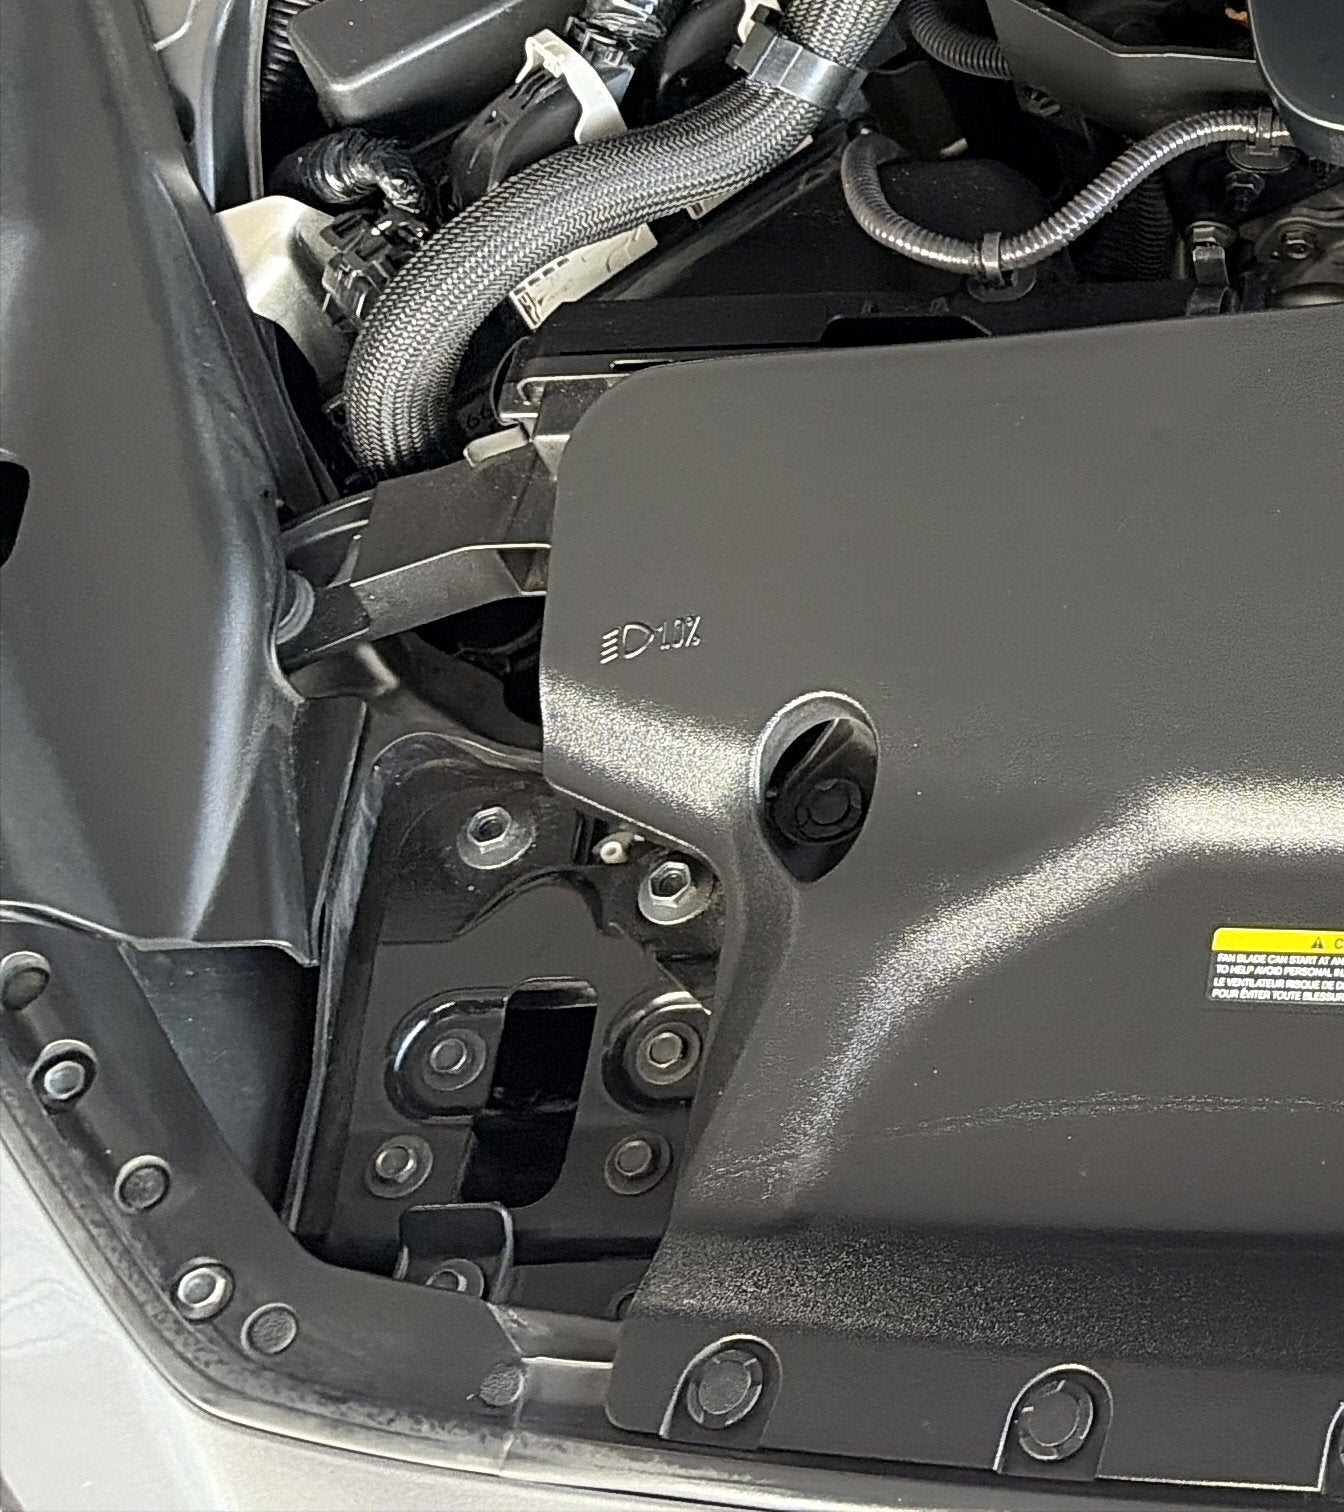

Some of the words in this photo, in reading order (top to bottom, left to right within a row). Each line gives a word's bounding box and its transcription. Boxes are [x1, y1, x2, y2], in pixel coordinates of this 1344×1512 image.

[1217, 953, 1236, 963] FAN
[1236, 953, 1267, 964] BLADE
[1267, 954, 1288, 964] CAN
[1288, 955, 1317, 965] START
[1318, 956, 1330, 965] AT
[1216, 964, 1230, 974] TO
[1230, 965, 1254, 975] HELP
[1254, 966, 1283, 976] AVOID
[1283, 966, 1333, 978] PERSONAL
[1213, 977, 1226, 987] LE
[1226, 977, 1285, 989] VENTILATEUR
[1285, 979, 1321, 989] RISQUE
[1321, 980, 1335, 990] DE
[1211, 988, 1240, 999] POUR
[1239, 987, 1272, 1000] ÉVITER
[1271, 990, 1302, 1000] TOUTE
